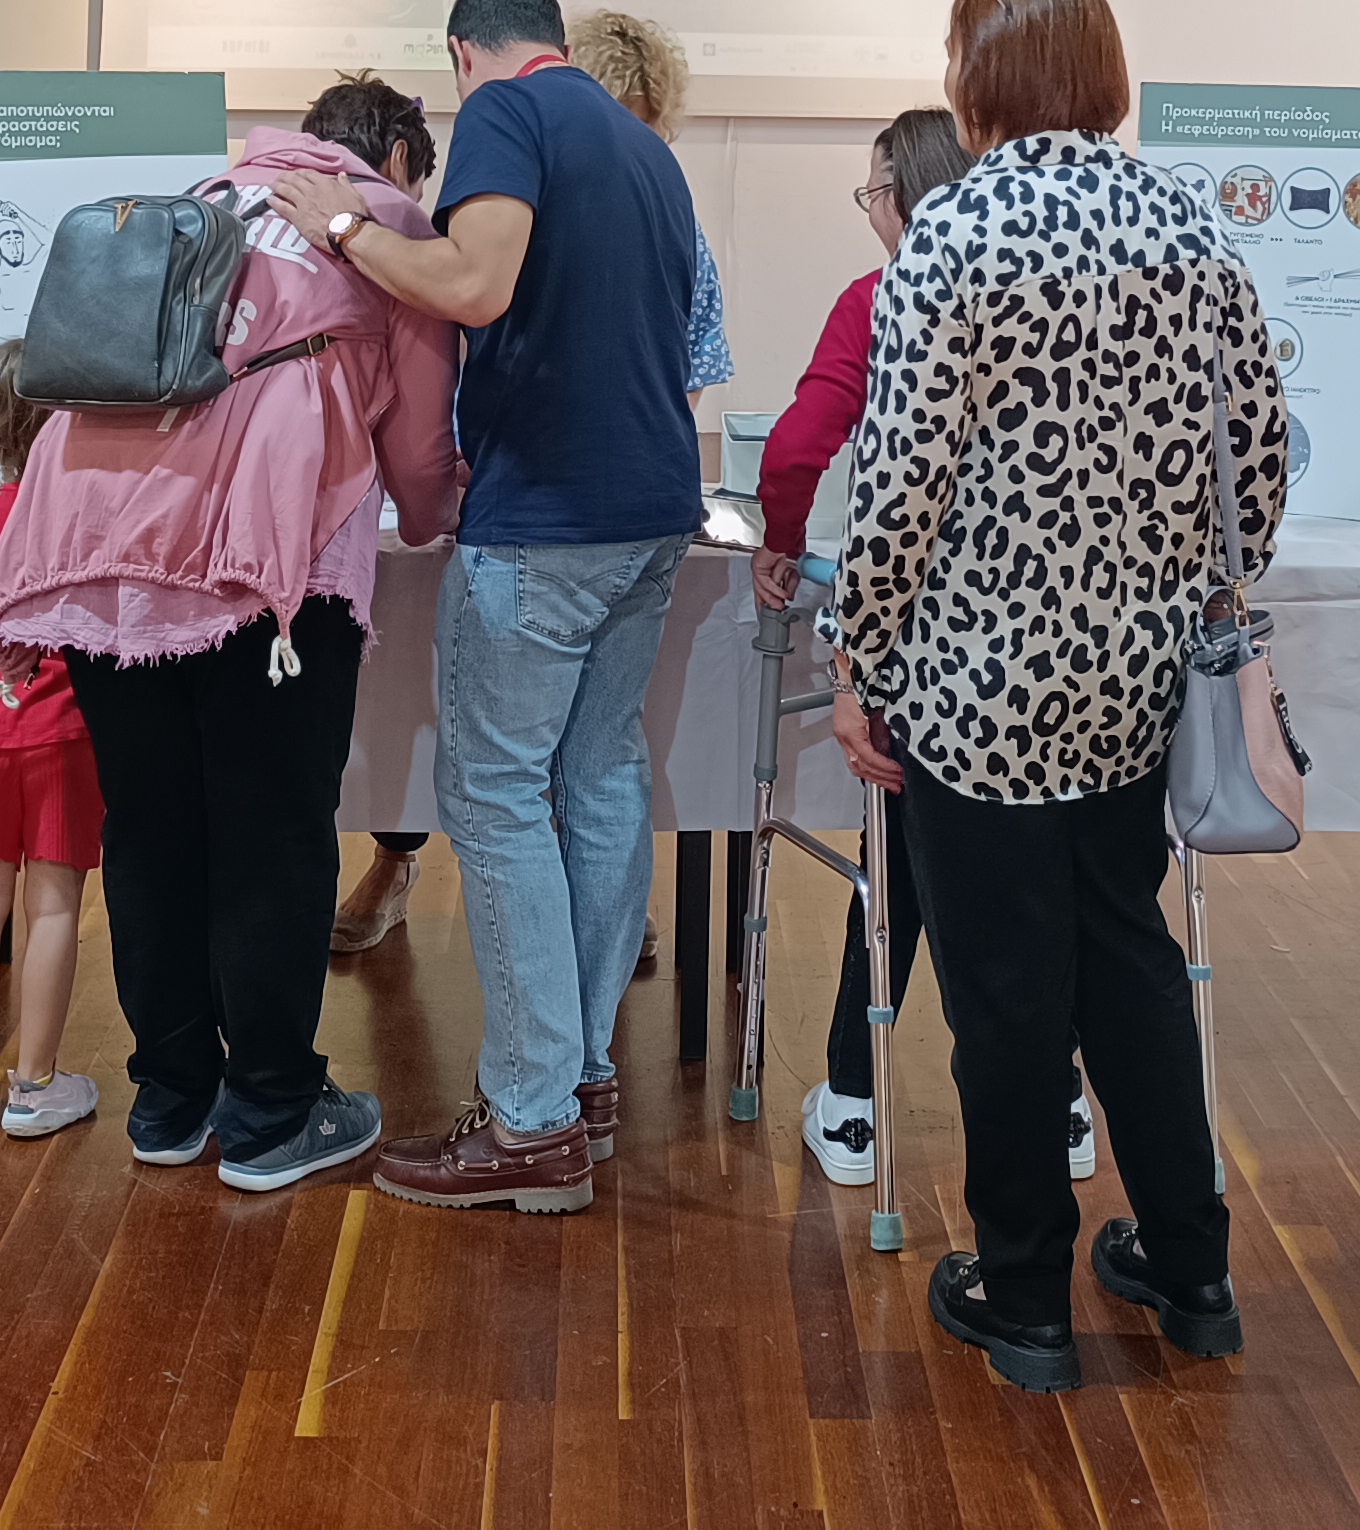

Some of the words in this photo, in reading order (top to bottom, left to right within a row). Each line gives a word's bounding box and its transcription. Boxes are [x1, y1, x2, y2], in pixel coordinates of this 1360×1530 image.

[1162, 103, 1260, 122] Προκερματική
[1264, 106, 1330, 123] περίοδος
[1161, 120, 1173, 133] Η
[1176, 122, 1260, 139] «εφεύρεση»
[1263, 126, 1289, 137] του
